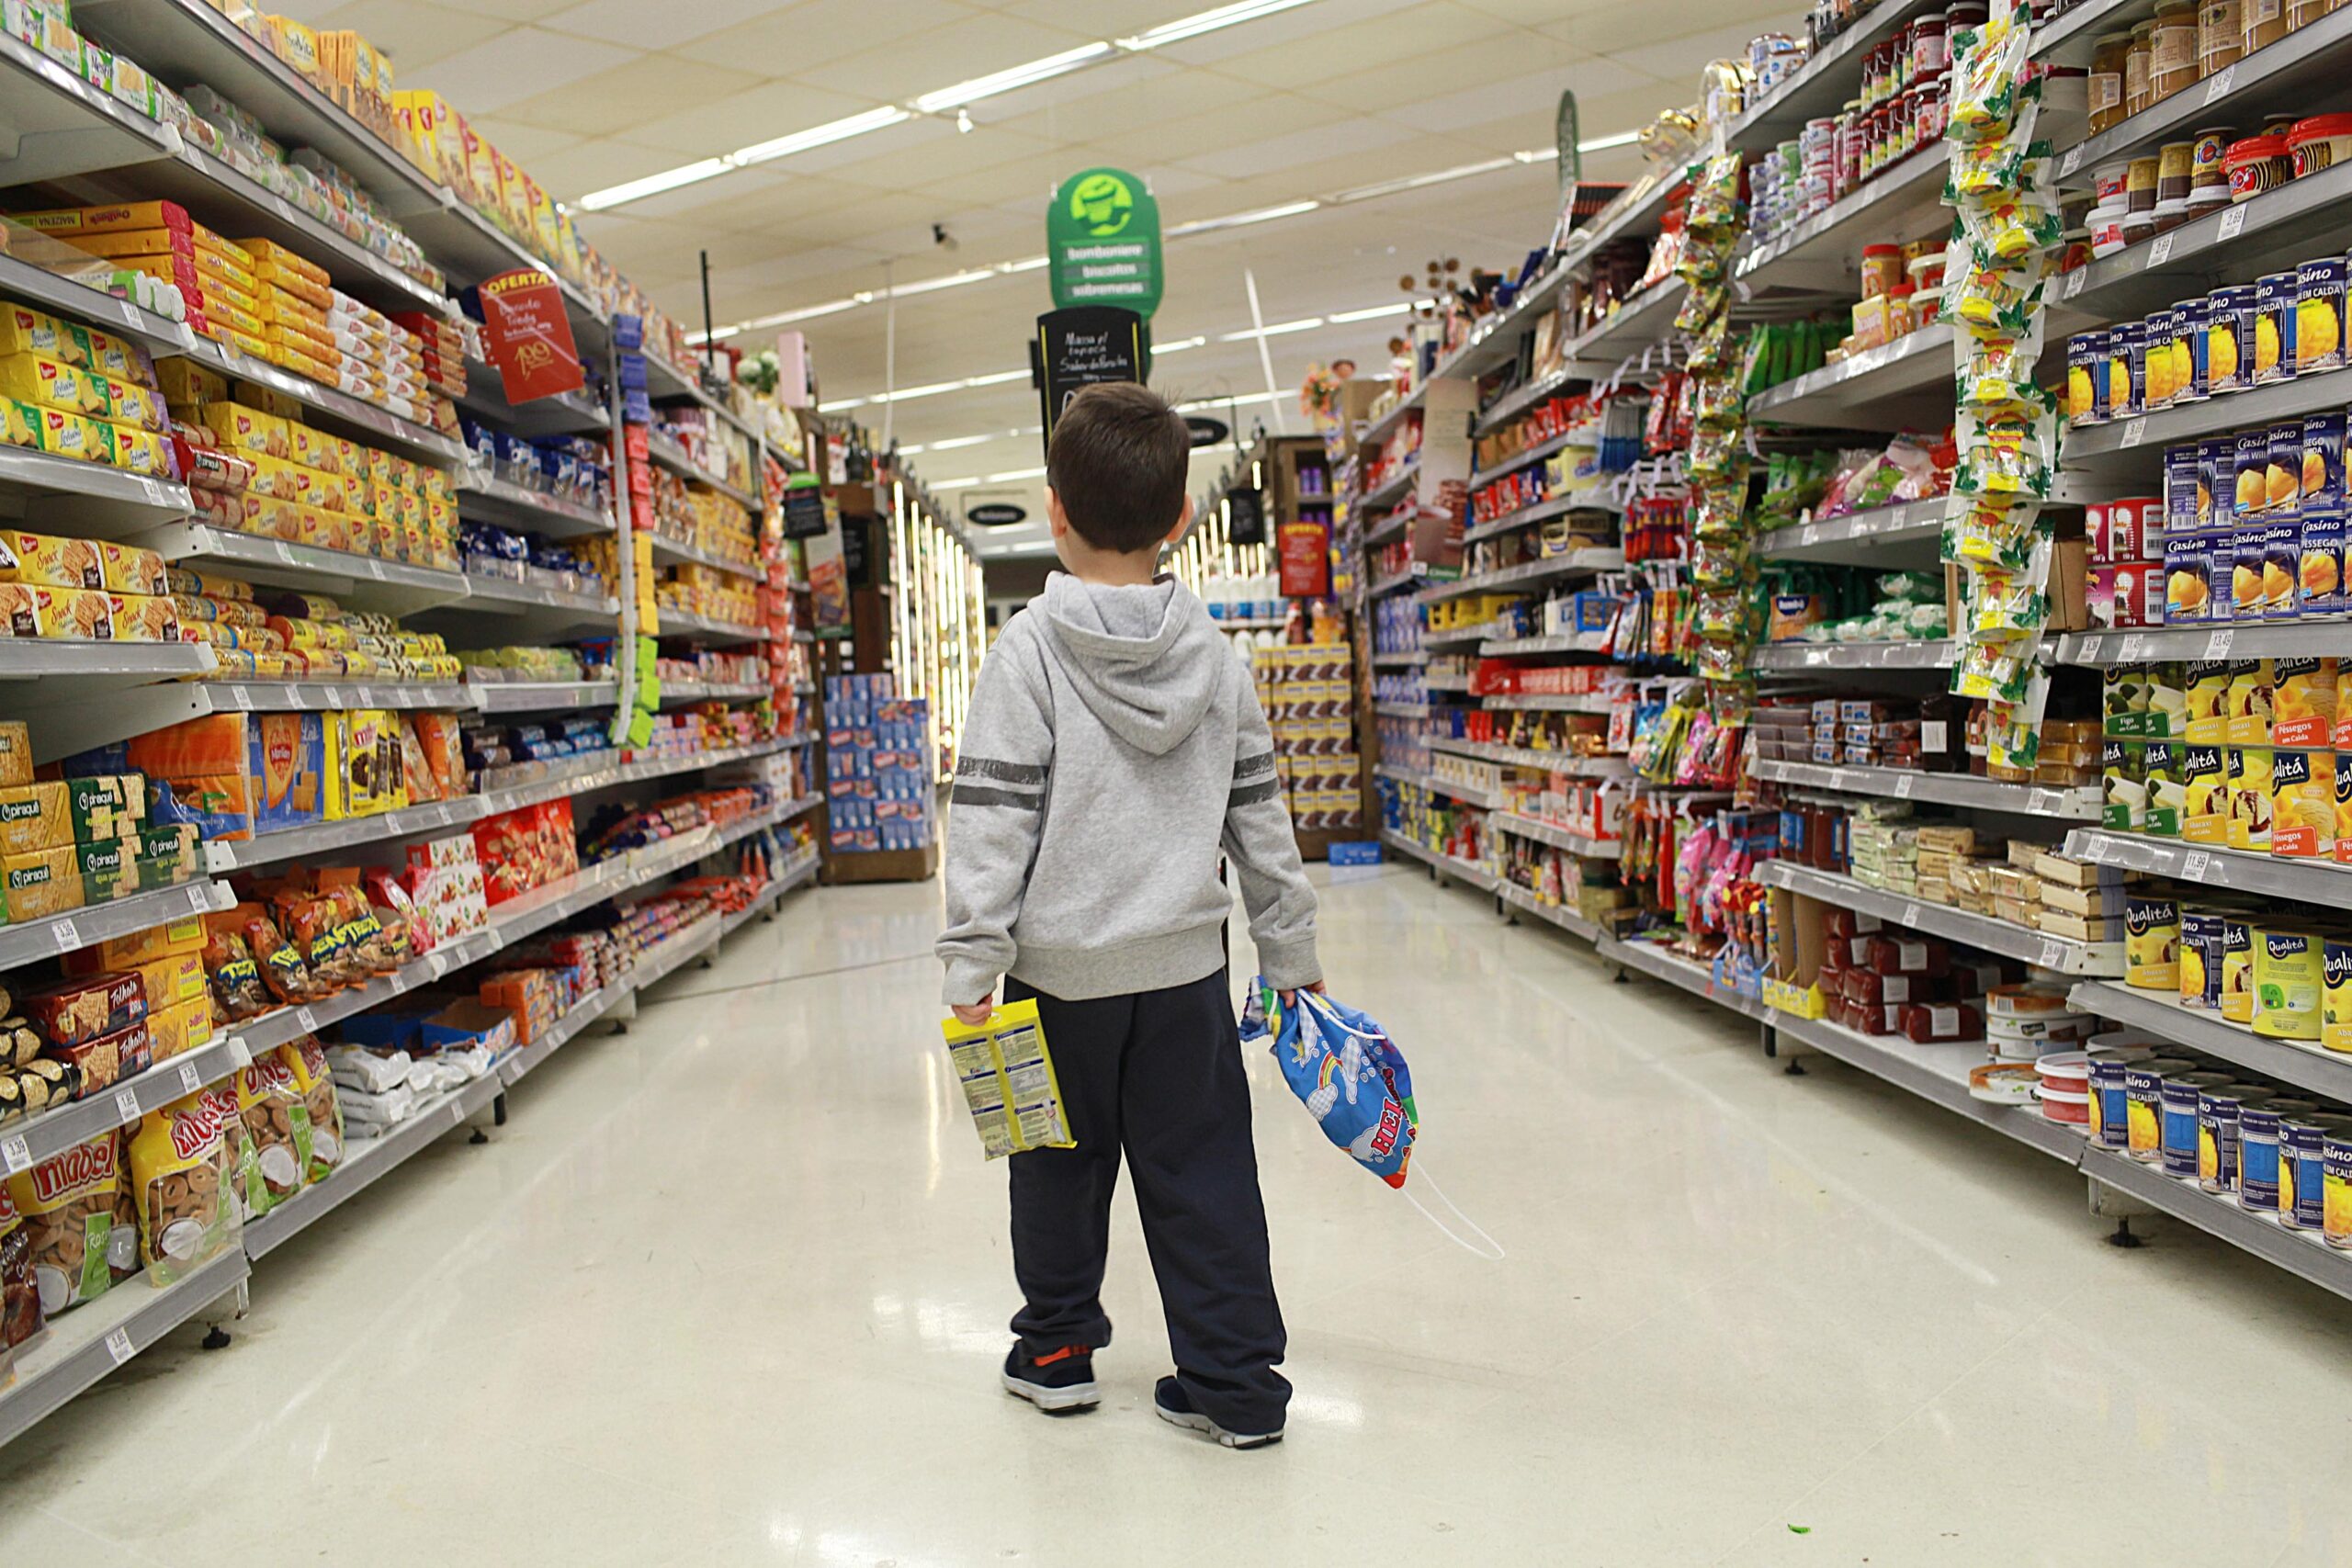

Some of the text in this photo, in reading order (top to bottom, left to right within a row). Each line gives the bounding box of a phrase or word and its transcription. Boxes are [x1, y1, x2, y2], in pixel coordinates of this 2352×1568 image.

[488, 273, 548, 295] OFERTA
[2312, 286, 2341, 298] CALDA
[2301, 519, 2340, 535] Casino
[2278, 722, 2312, 735] Pêssegos
[2291, 733, 2309, 742] Calda
[2188, 855, 2207, 870] 11.99
[2127, 903, 2173, 925] Qualitá
[58, 922, 75, 938] 3.39
[2268, 934, 2304, 952] Qualitá
[2137, 1093, 2159, 1102] CALDA
